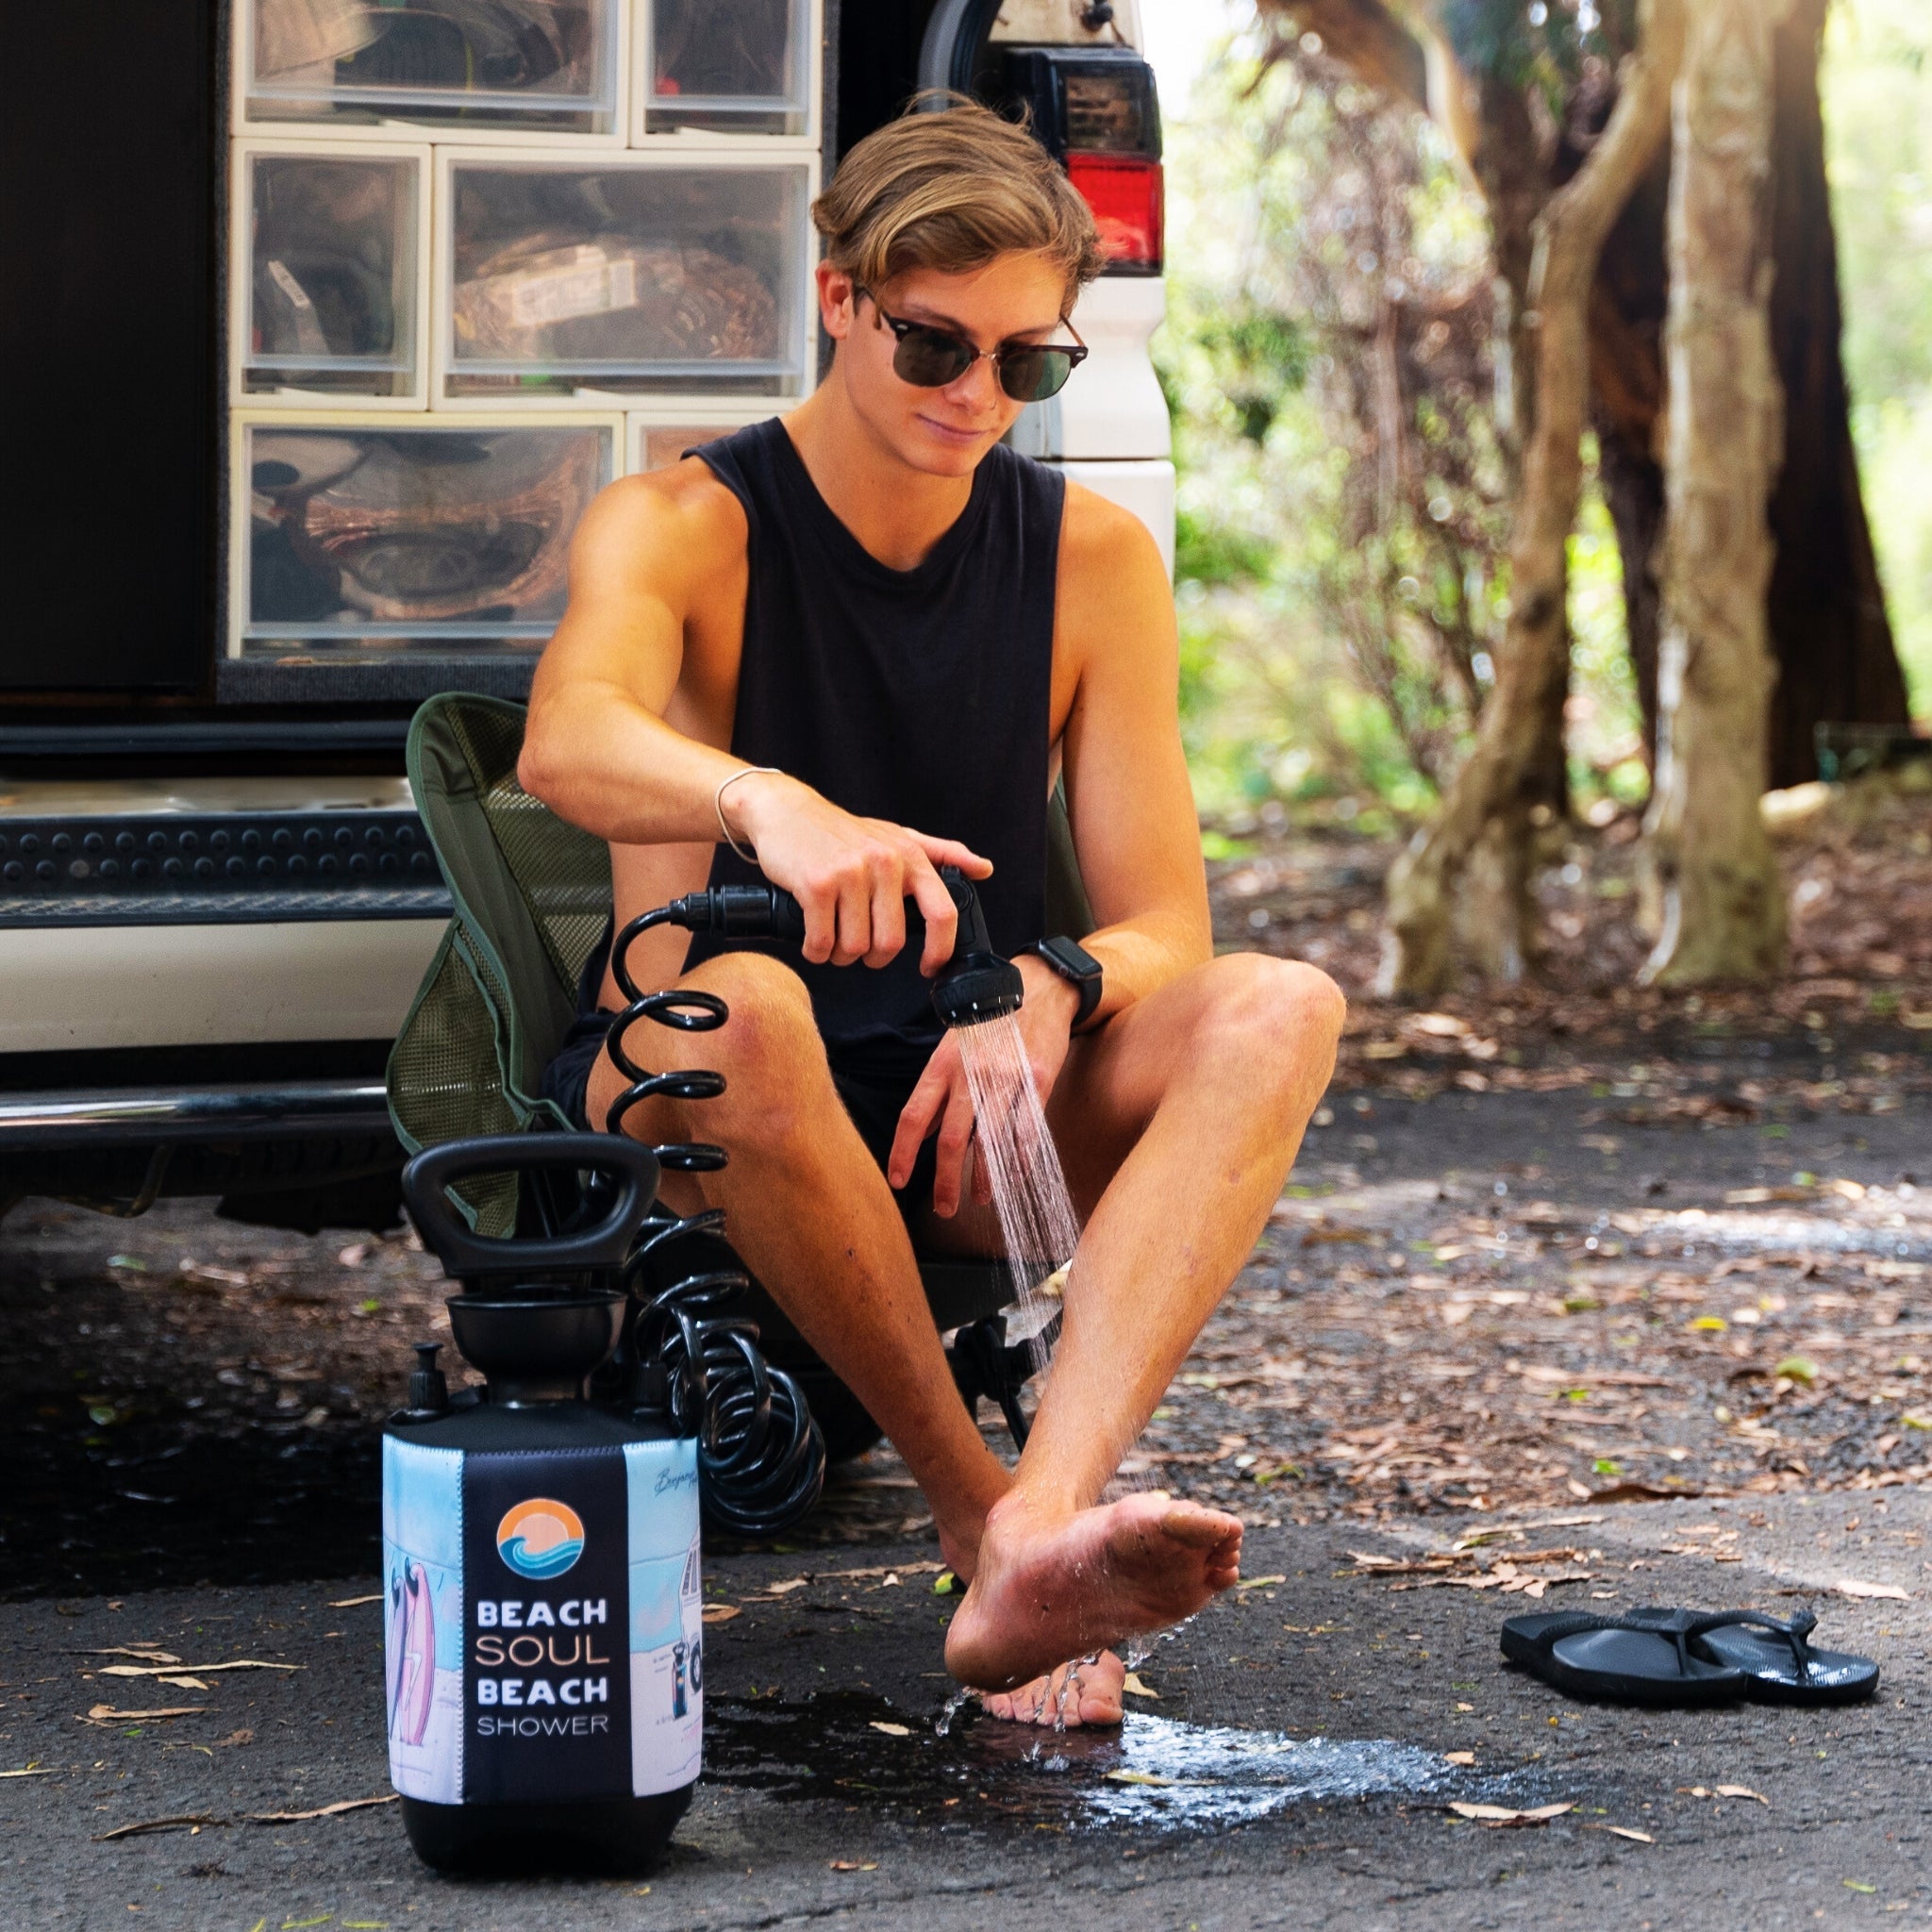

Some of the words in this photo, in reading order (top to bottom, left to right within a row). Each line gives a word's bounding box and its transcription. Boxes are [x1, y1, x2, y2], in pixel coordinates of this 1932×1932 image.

[476, 1599, 608, 1628] BEACH
[475, 1634, 610, 1667] SOUL
[476, 1677, 608, 1707] BEACH
[475, 1714, 609, 1737] SHOWER
